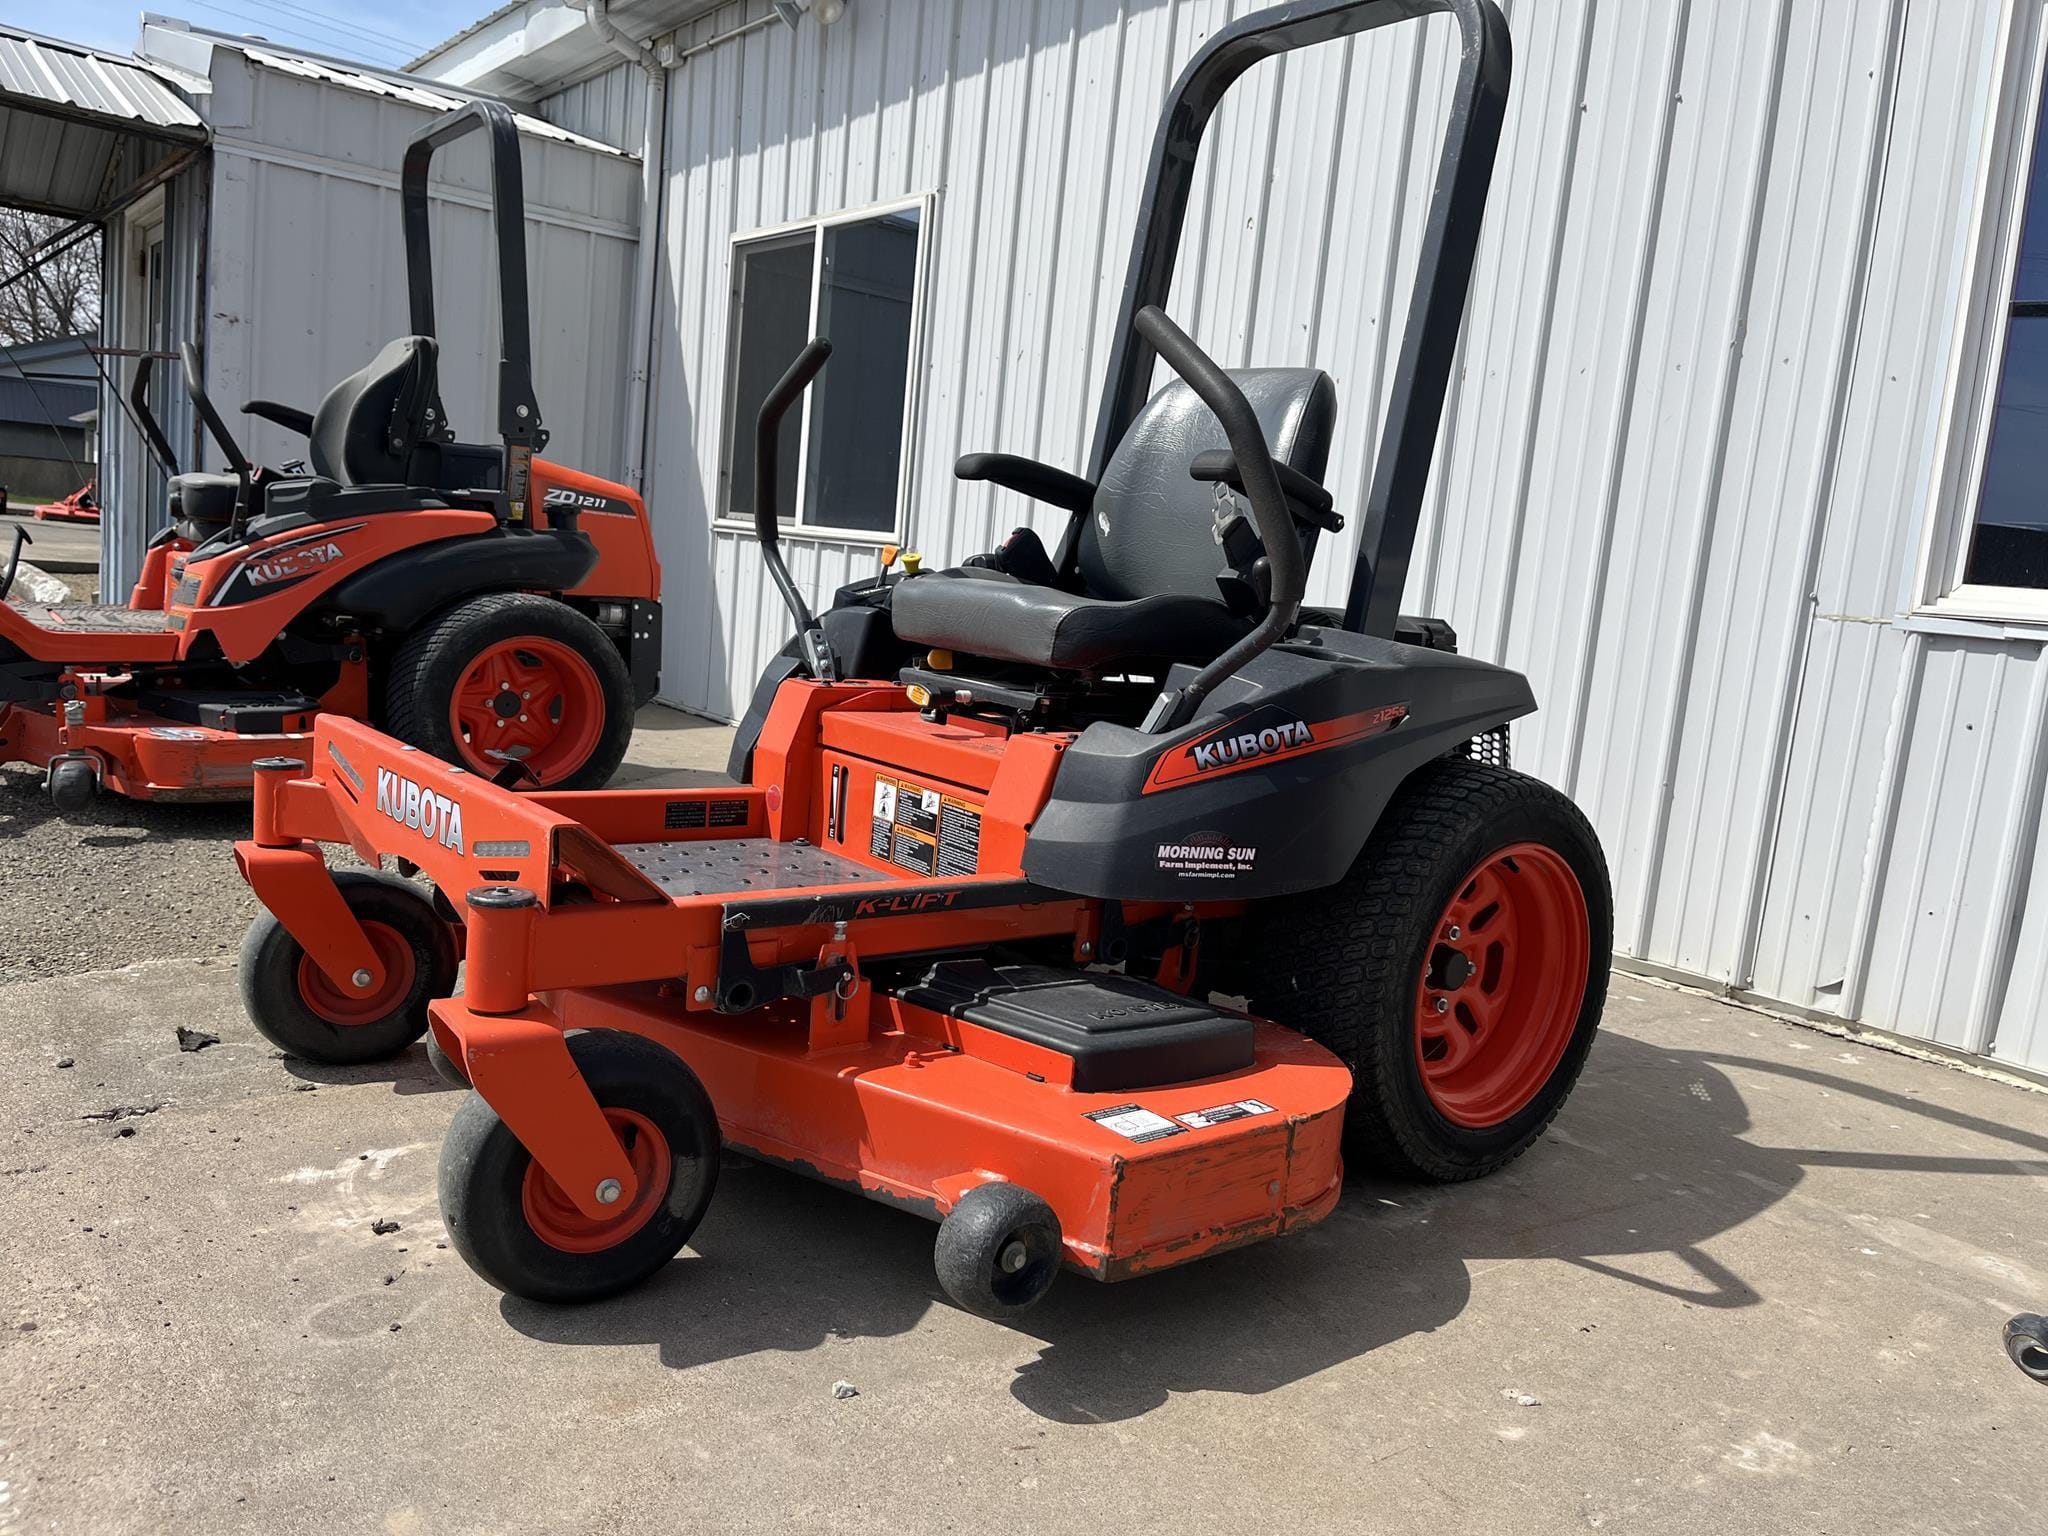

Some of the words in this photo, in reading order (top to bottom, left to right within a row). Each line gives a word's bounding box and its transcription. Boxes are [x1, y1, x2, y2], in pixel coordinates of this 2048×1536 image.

[1193, 720, 1313, 770] KUBOTA
[377, 766, 465, 857] KUBOTA
[1157, 845, 1224, 860] MORNING
[1227, 847, 1256, 861] SUN
[1159, 860, 1184, 868] Farm
[1185, 861, 1235, 871] Implement,
[1178, 871, 1235, 879] msfarmimpl.com
[855, 891, 962, 914] K-LIFT
